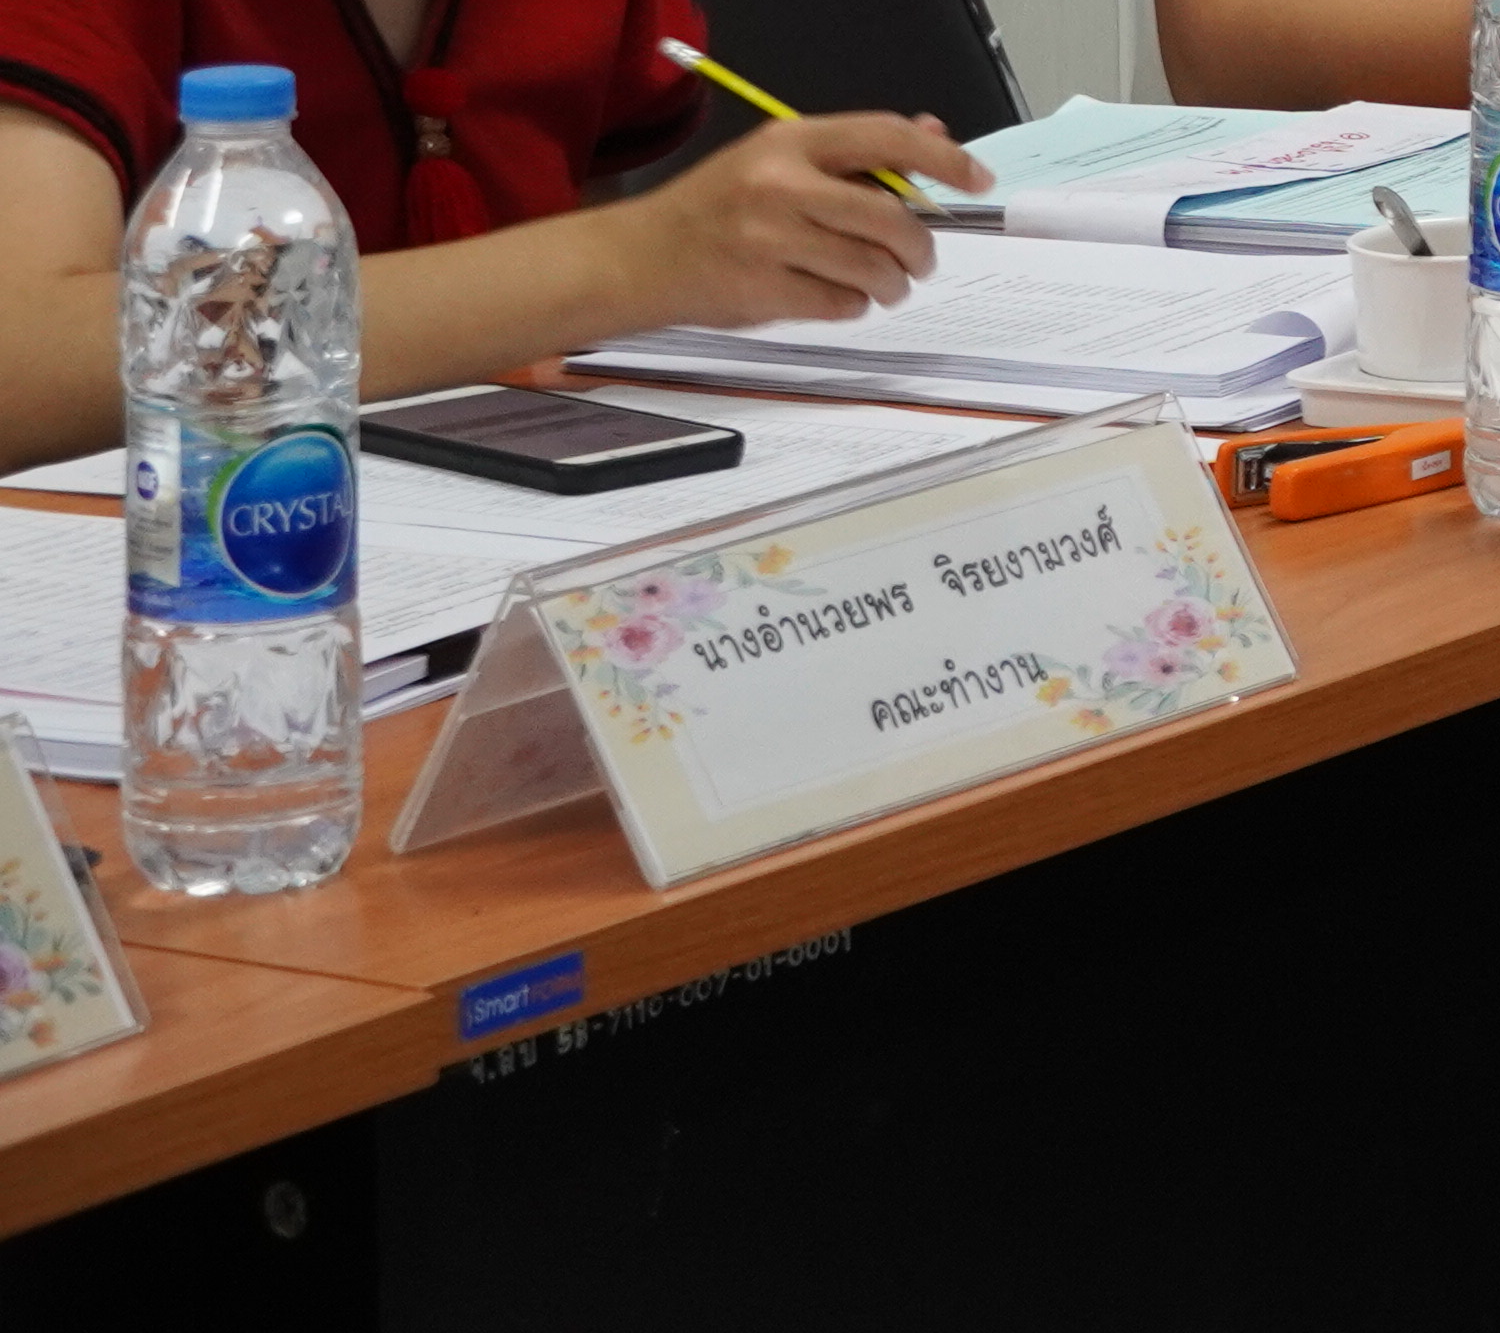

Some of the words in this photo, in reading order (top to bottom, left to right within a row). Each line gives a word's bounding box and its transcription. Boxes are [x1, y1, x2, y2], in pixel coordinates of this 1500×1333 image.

[693, 582, 914, 672] นางอำนวยพร
[933, 504, 1122, 598] จิรยงามวงศ์
[871, 651, 1049, 733] คณะทำงาน
